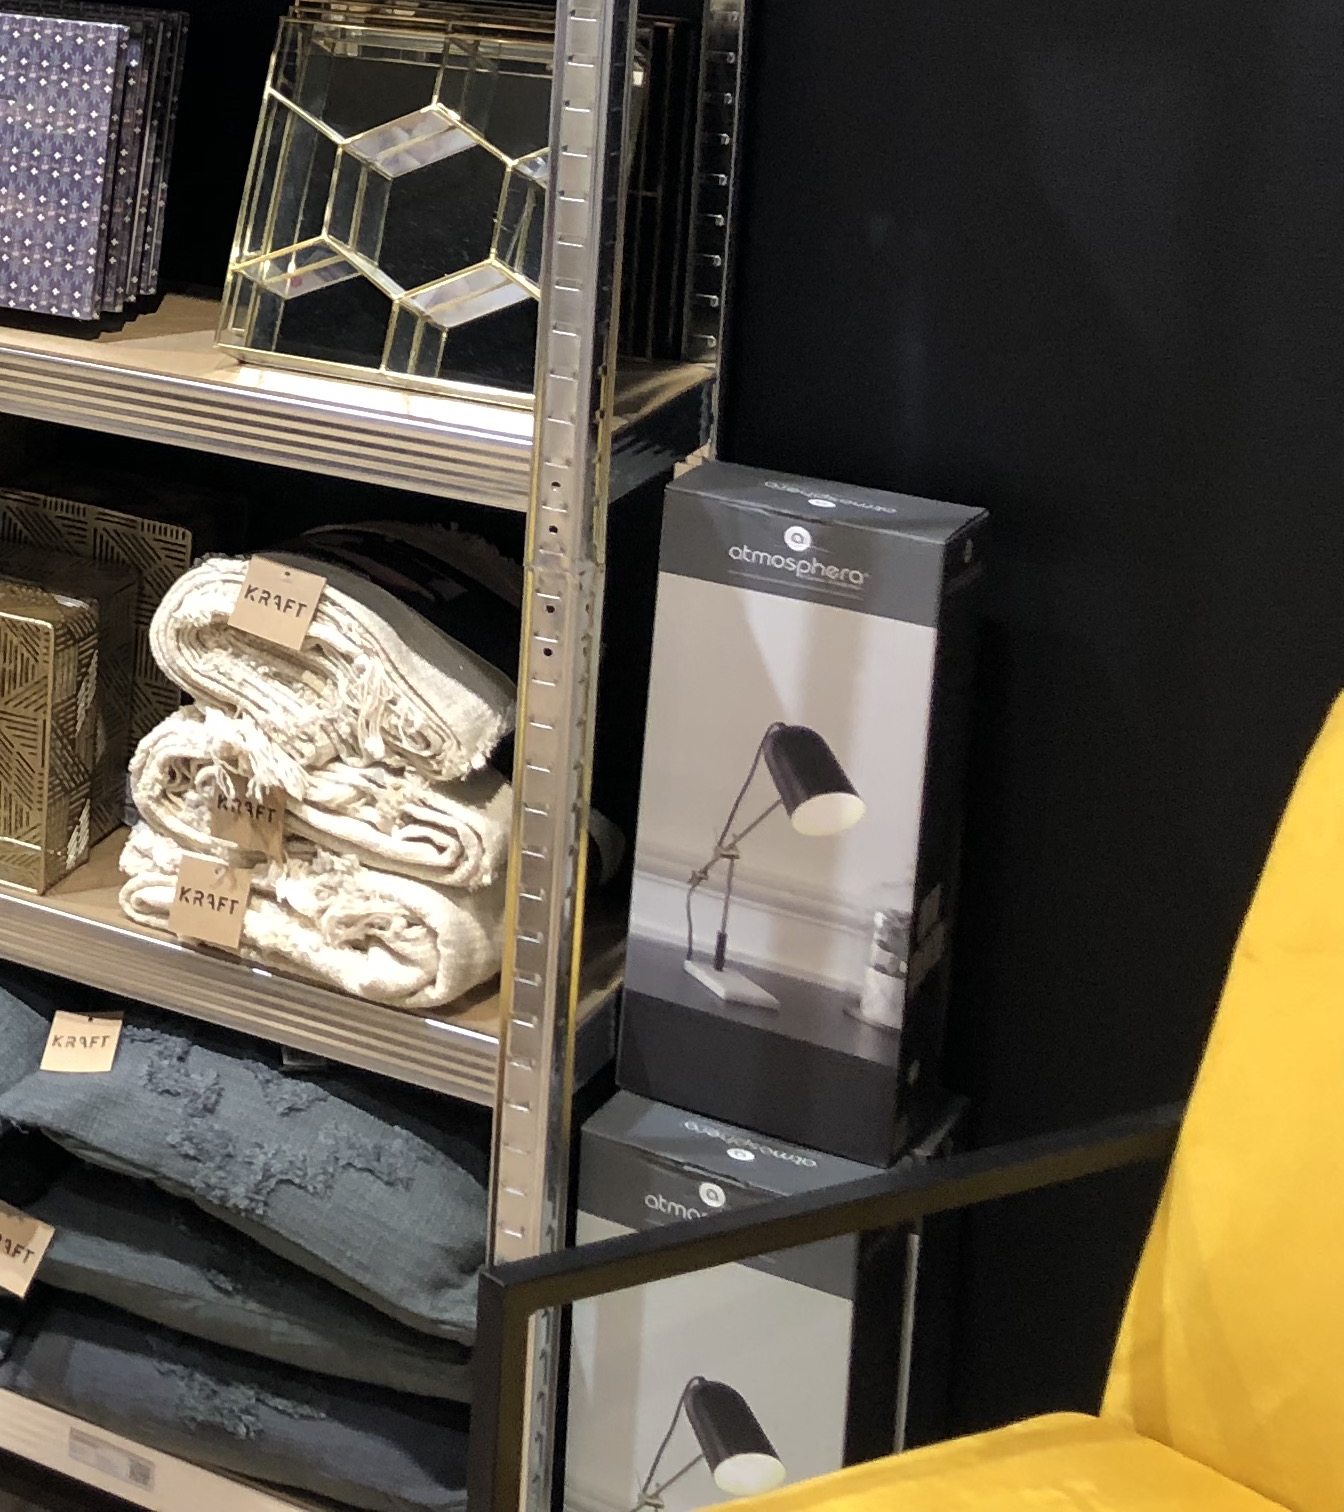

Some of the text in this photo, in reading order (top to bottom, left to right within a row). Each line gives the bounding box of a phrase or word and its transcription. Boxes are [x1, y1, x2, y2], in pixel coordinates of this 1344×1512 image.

[728, 544, 866, 586] atmosphera
[244, 584, 308, 618] KRAFT
[216, 795, 276, 824] KRAFT
[178, 886, 240, 916] KRAFT
[50, 1034, 112, 1050] KRAFT
